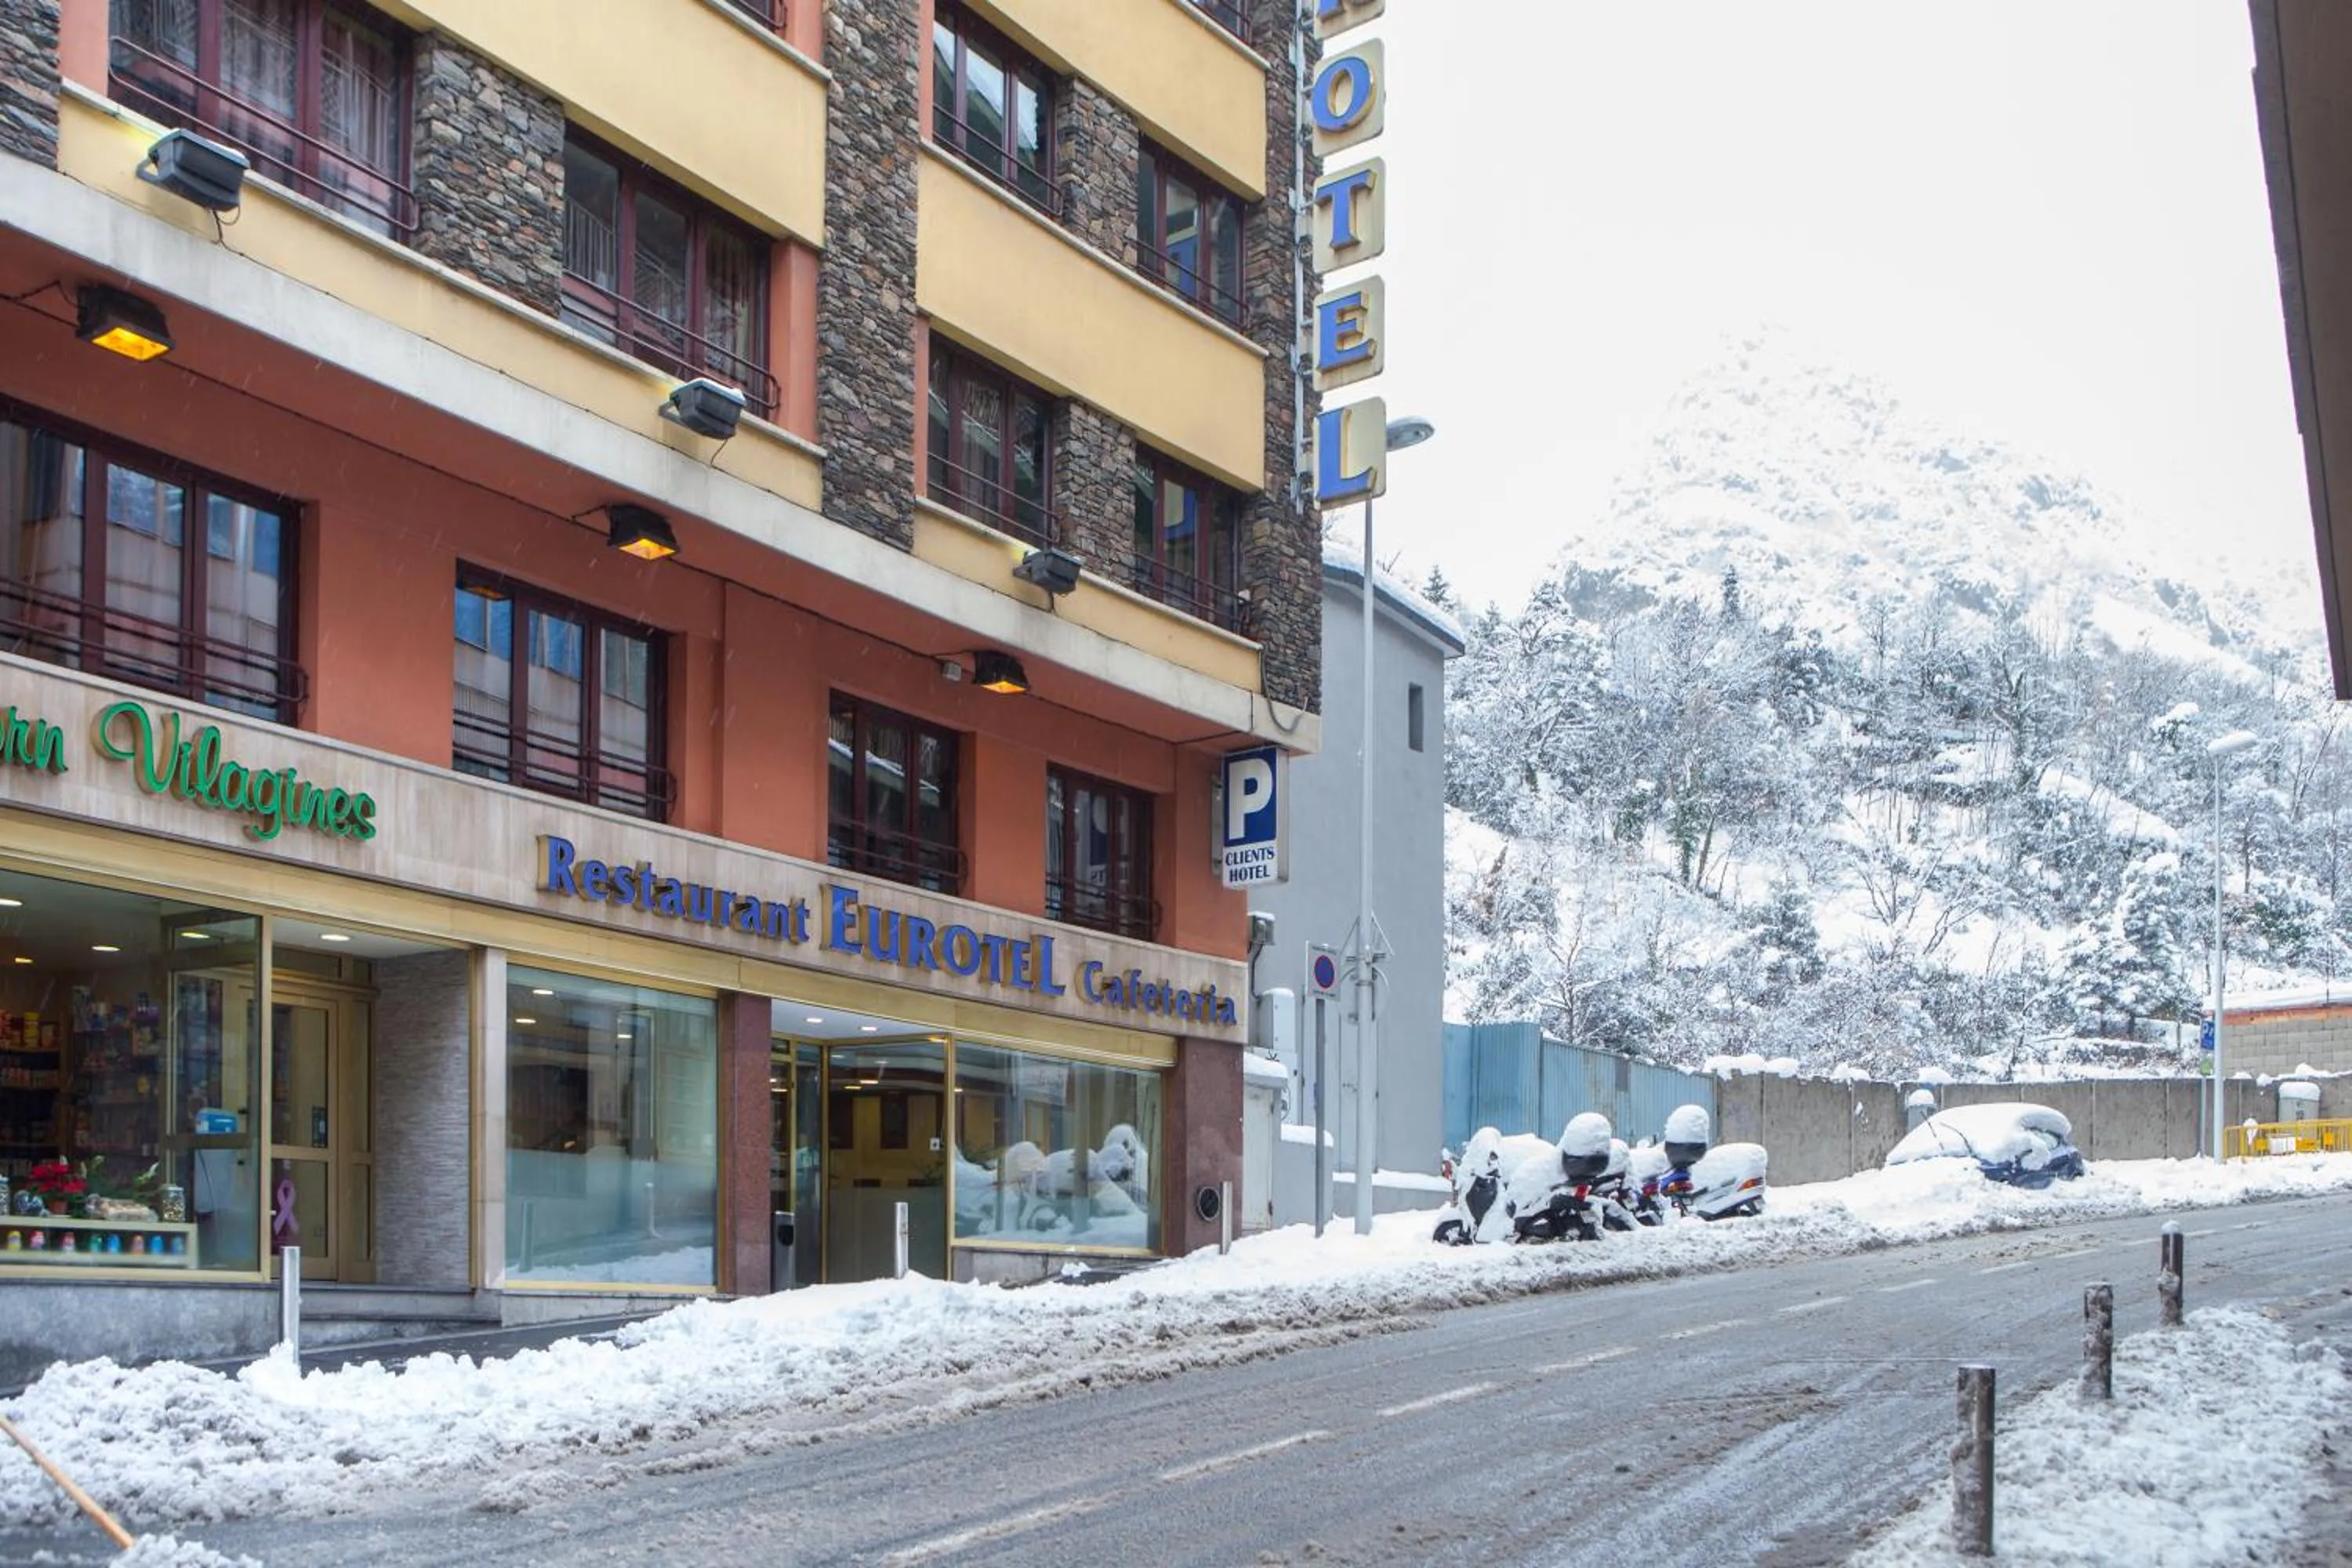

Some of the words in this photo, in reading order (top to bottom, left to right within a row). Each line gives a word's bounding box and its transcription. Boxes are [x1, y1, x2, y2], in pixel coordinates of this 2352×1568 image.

[1312, 0, 1375, 500] OTEL
[0, 706, 68, 773] rn
[92, 702, 376, 841] Vilagines
[1229, 758, 1272, 840] P
[1225, 847, 1274, 866] CLIENTS
[1229, 865, 1270, 883] HOTEL
[538, 835, 810, 943] Restaurant
[820, 884, 1066, 996] EUROTEL
[1076, 960, 1237, 1025] Cafeteria
